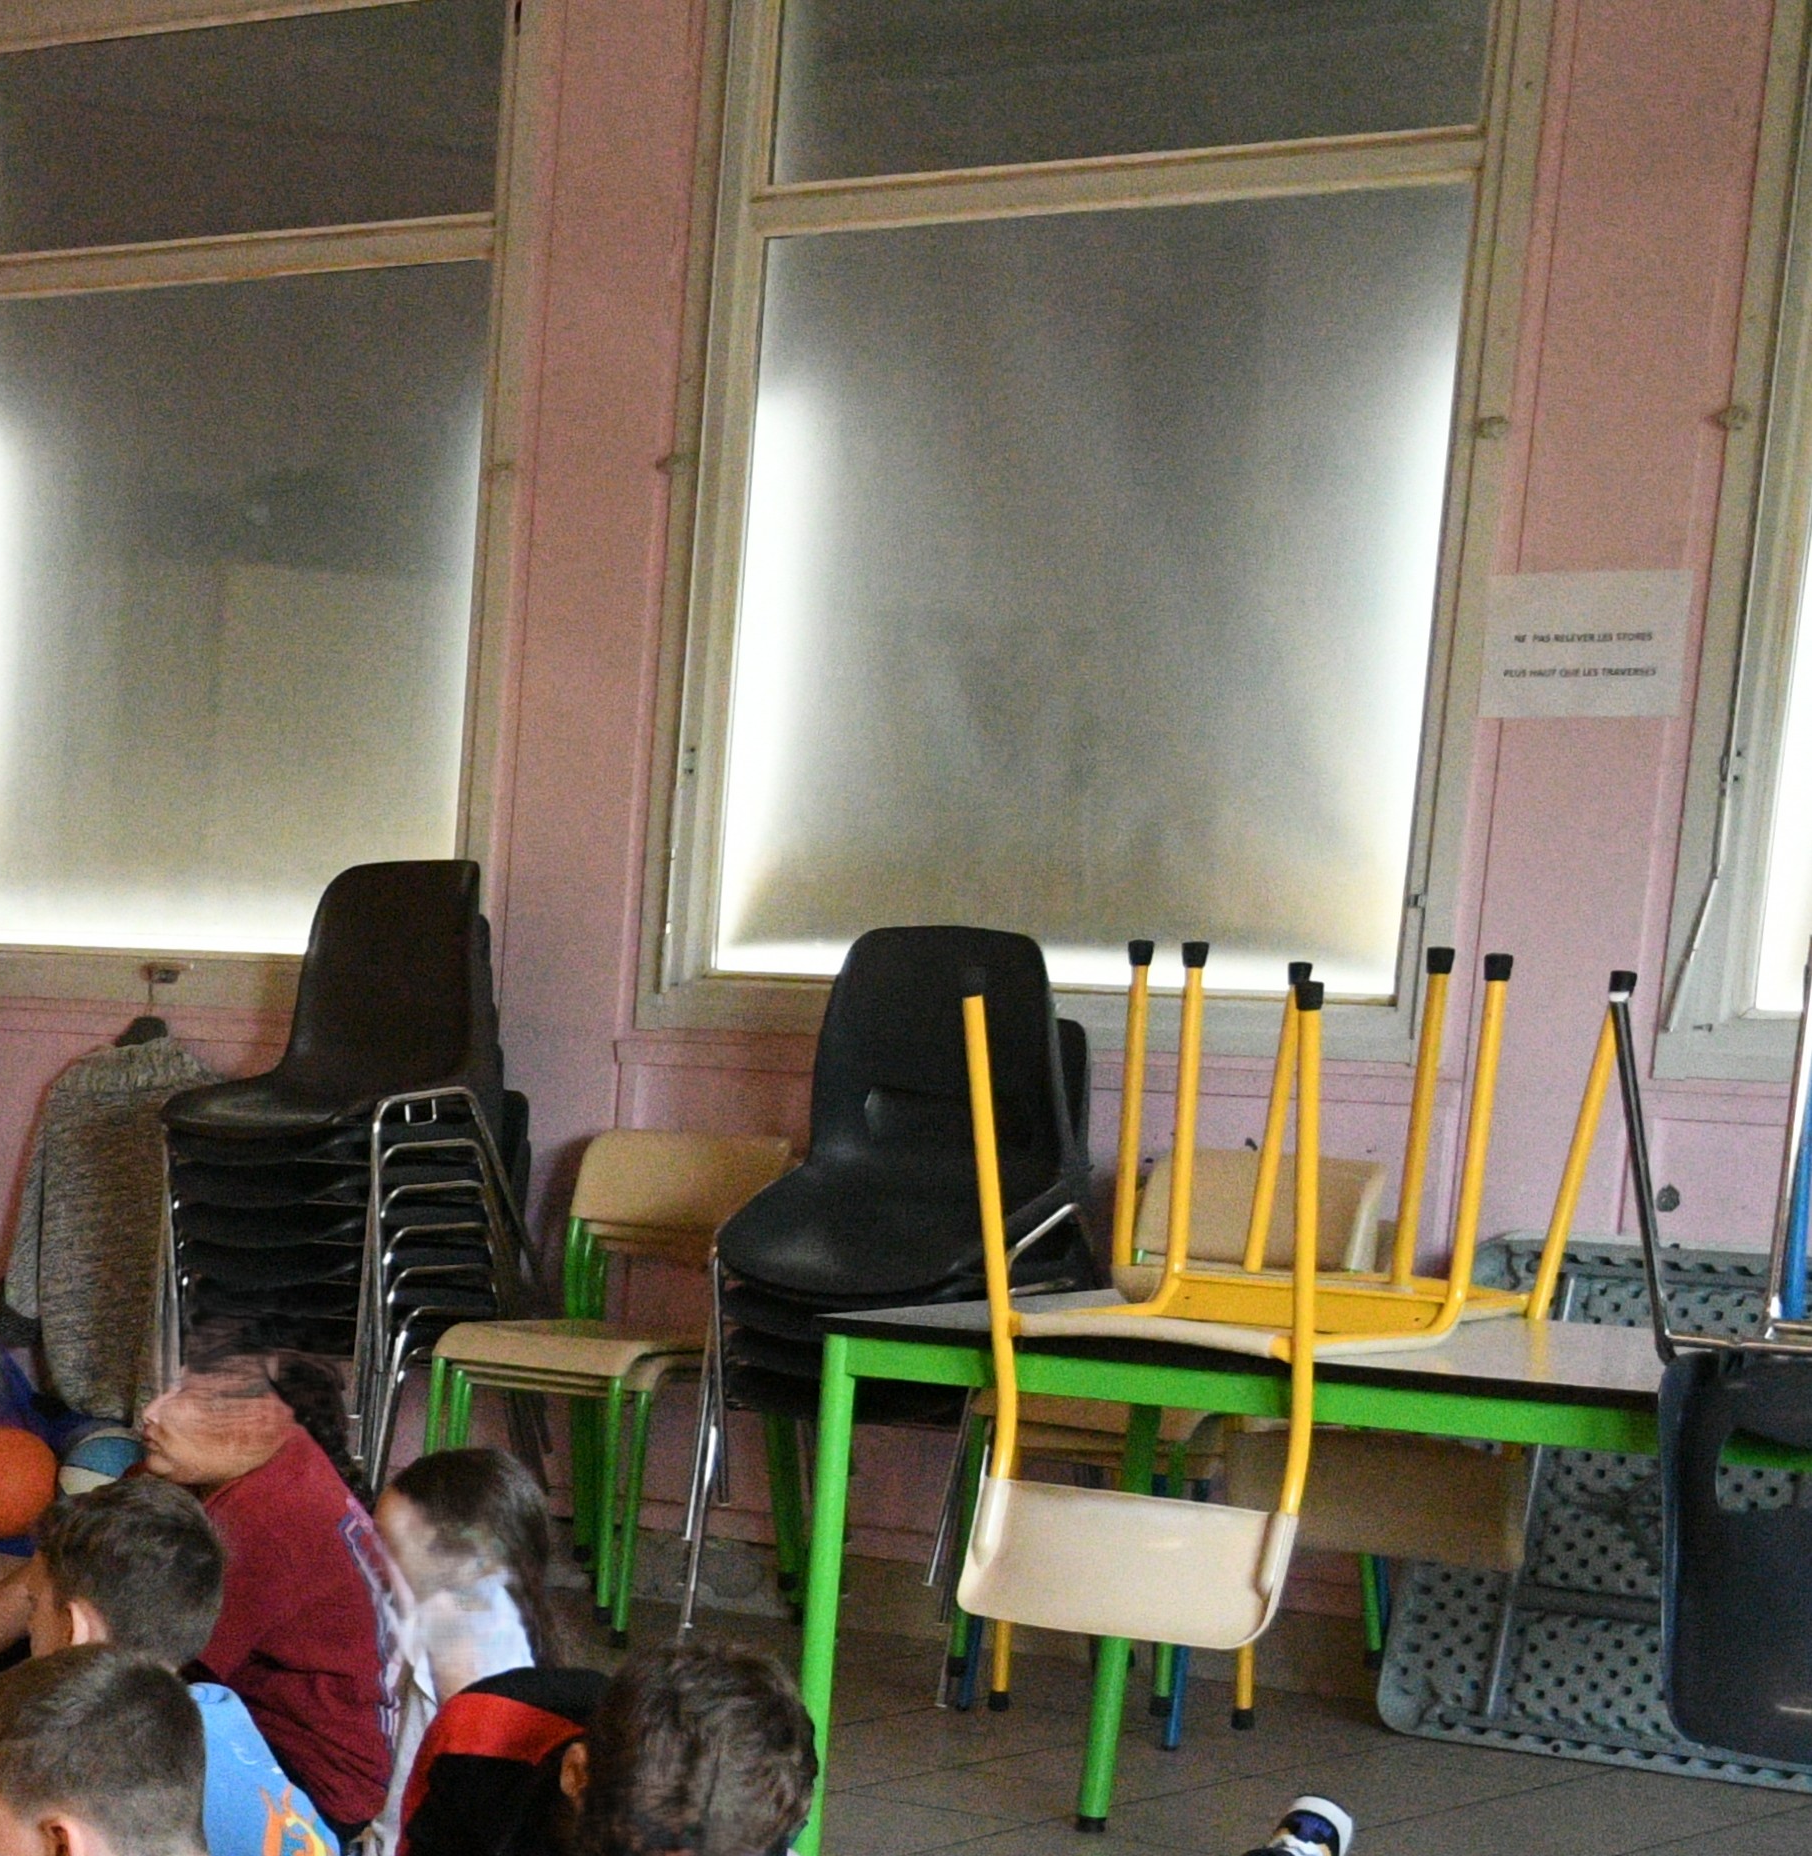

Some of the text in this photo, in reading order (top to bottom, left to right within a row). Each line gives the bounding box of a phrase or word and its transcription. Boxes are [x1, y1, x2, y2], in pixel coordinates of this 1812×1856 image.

[1513, 631, 1653, 643] NE PAS RELEVER LES STORES
[1503, 666, 1657, 678] PLUS HAUT QUE LES TRAVERSES
